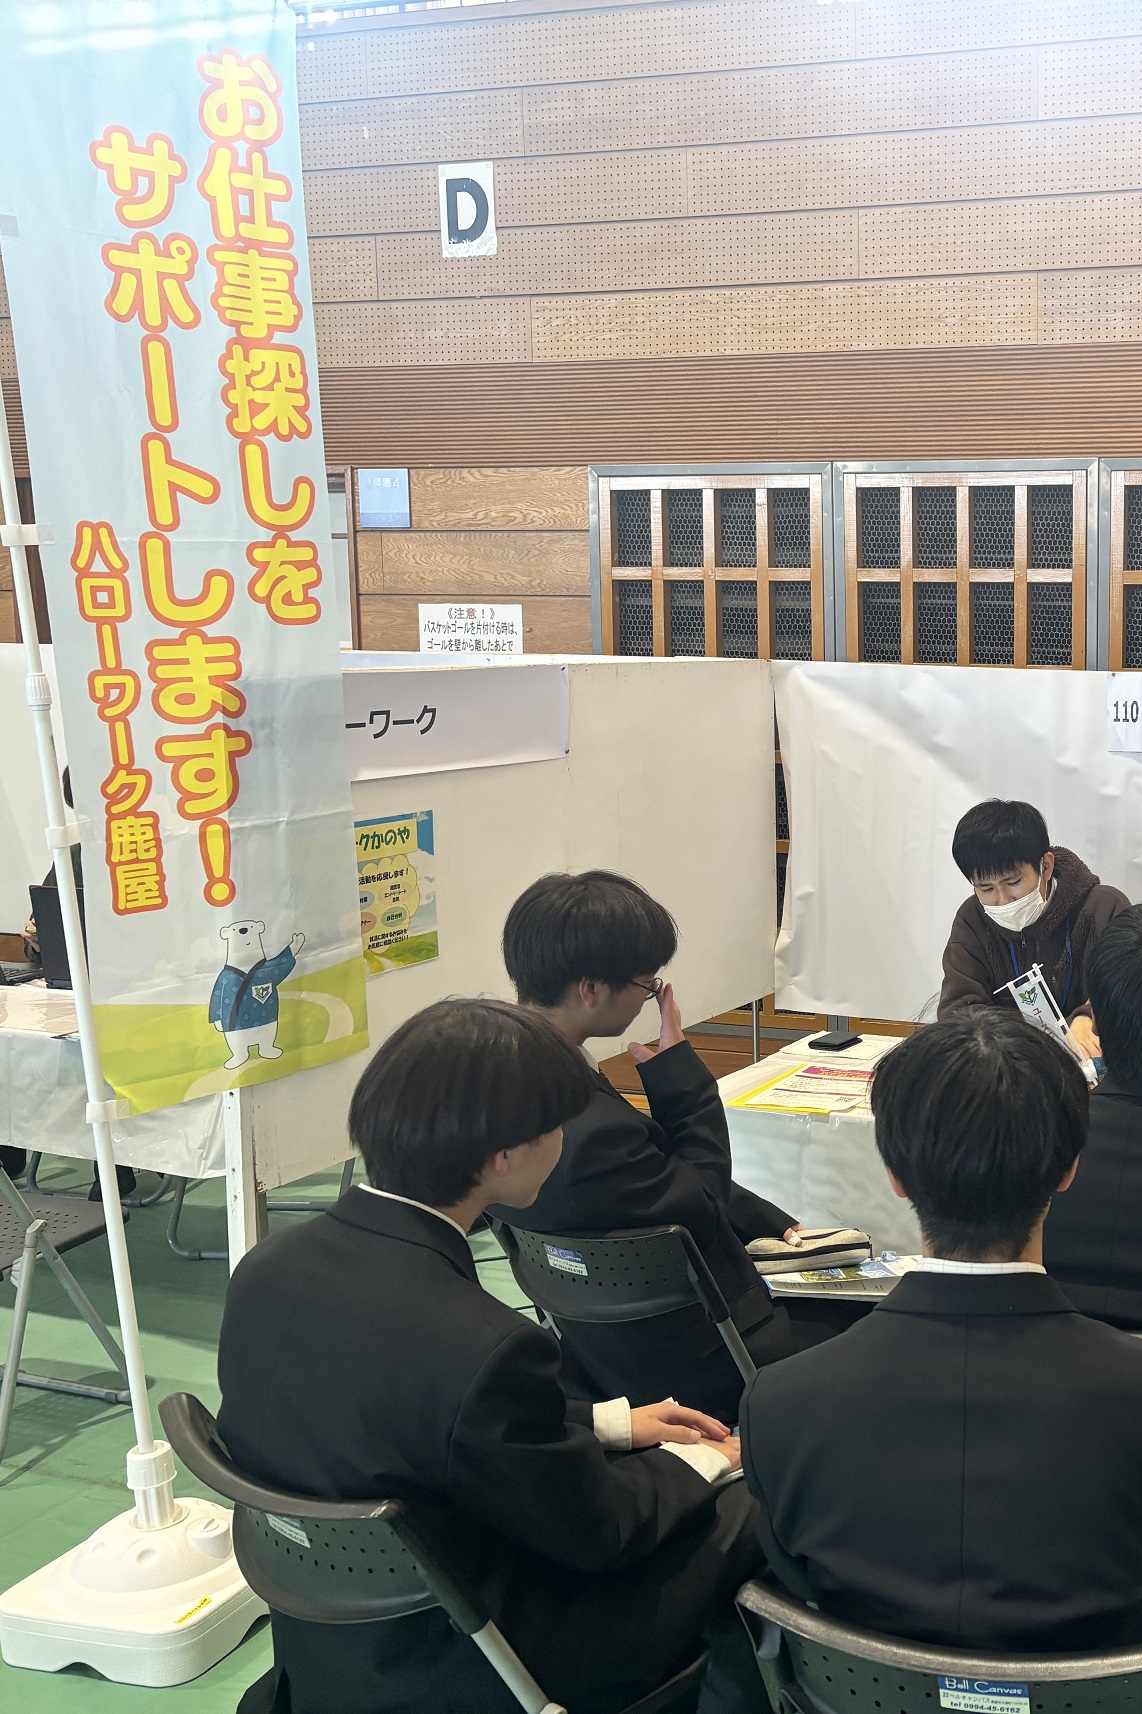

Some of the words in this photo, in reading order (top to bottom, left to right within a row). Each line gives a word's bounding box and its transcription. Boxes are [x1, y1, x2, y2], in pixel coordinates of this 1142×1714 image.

[446, 177, 488, 243] D
[201, 51, 320, 623] お仕事探しを
[95, 129, 249, 905] サポートします！
[427, 638, 513, 652] ゴールを壁から離したあとで
[74, 522, 165, 913] ハローワーク鹿屋
[1113, 700, 1139, 723] 110
[356, 826, 410, 851] クかのや
[945, 1677, 969, 1690] Bell
[974, 1681, 1023, 1695] Canvas
